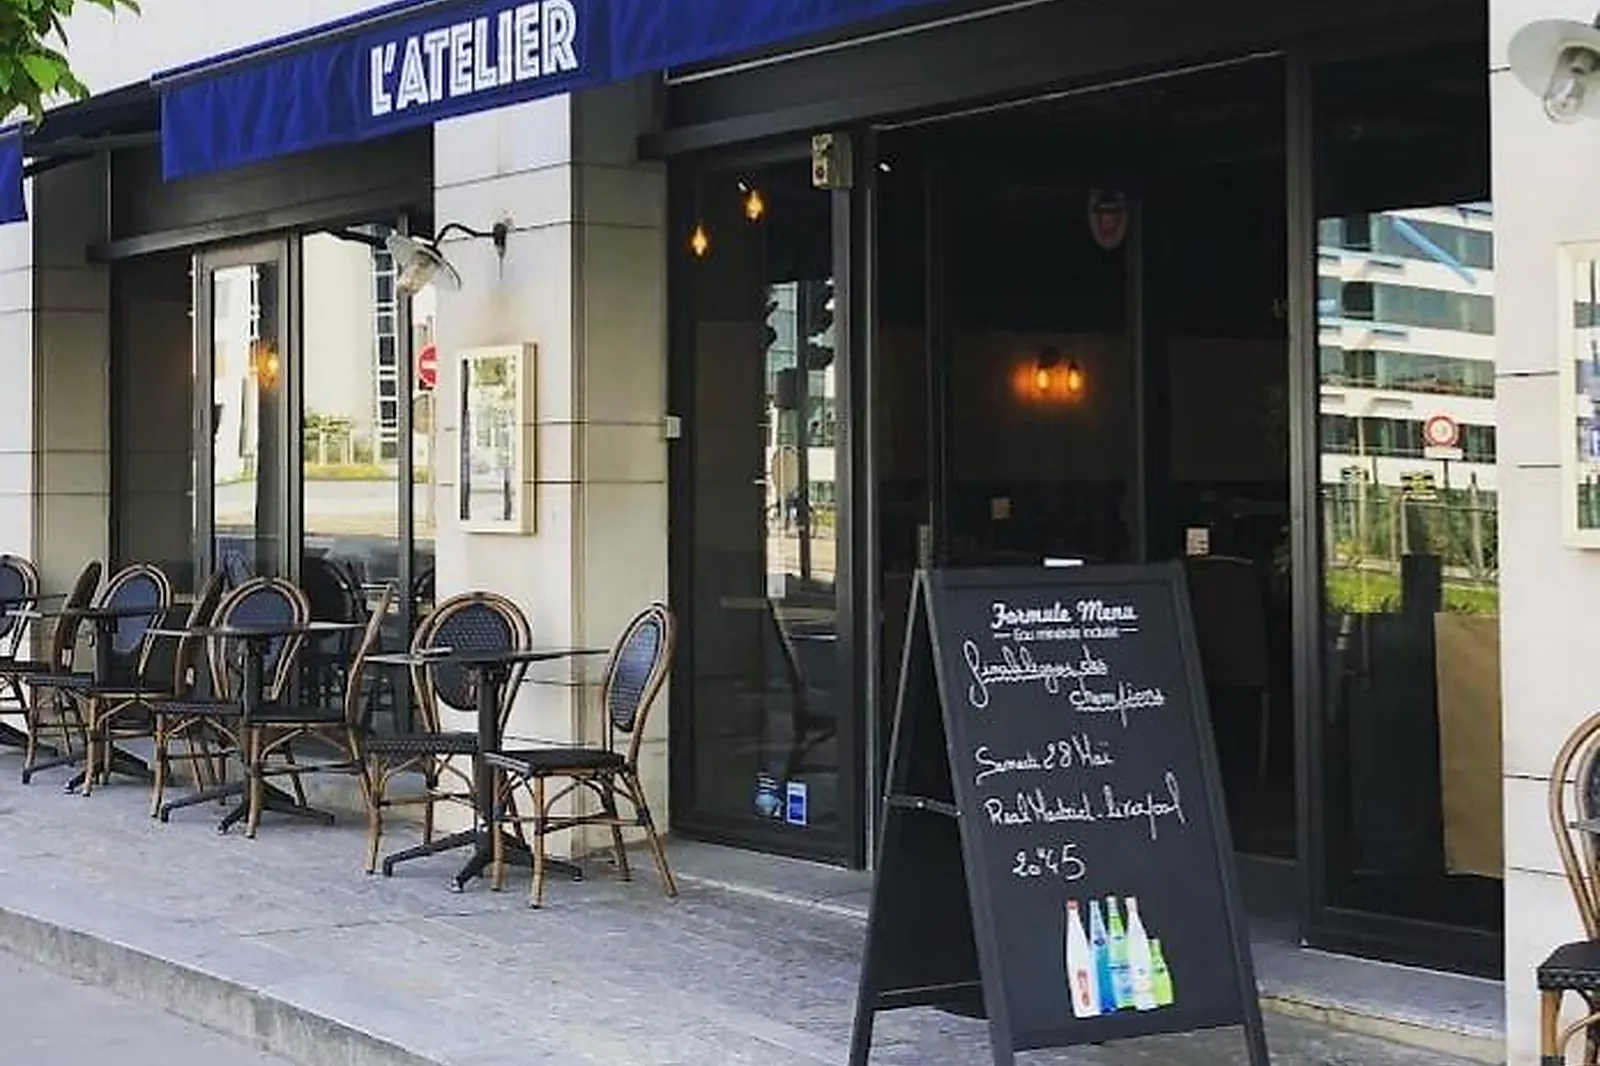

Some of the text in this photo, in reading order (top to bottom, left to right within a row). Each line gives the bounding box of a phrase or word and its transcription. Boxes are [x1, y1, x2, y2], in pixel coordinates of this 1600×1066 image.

[370, 0, 578, 116] L'ATELIER
[991, 600, 1138, 629] Formule Menu
[1043, 741, 1071, 770] 28
